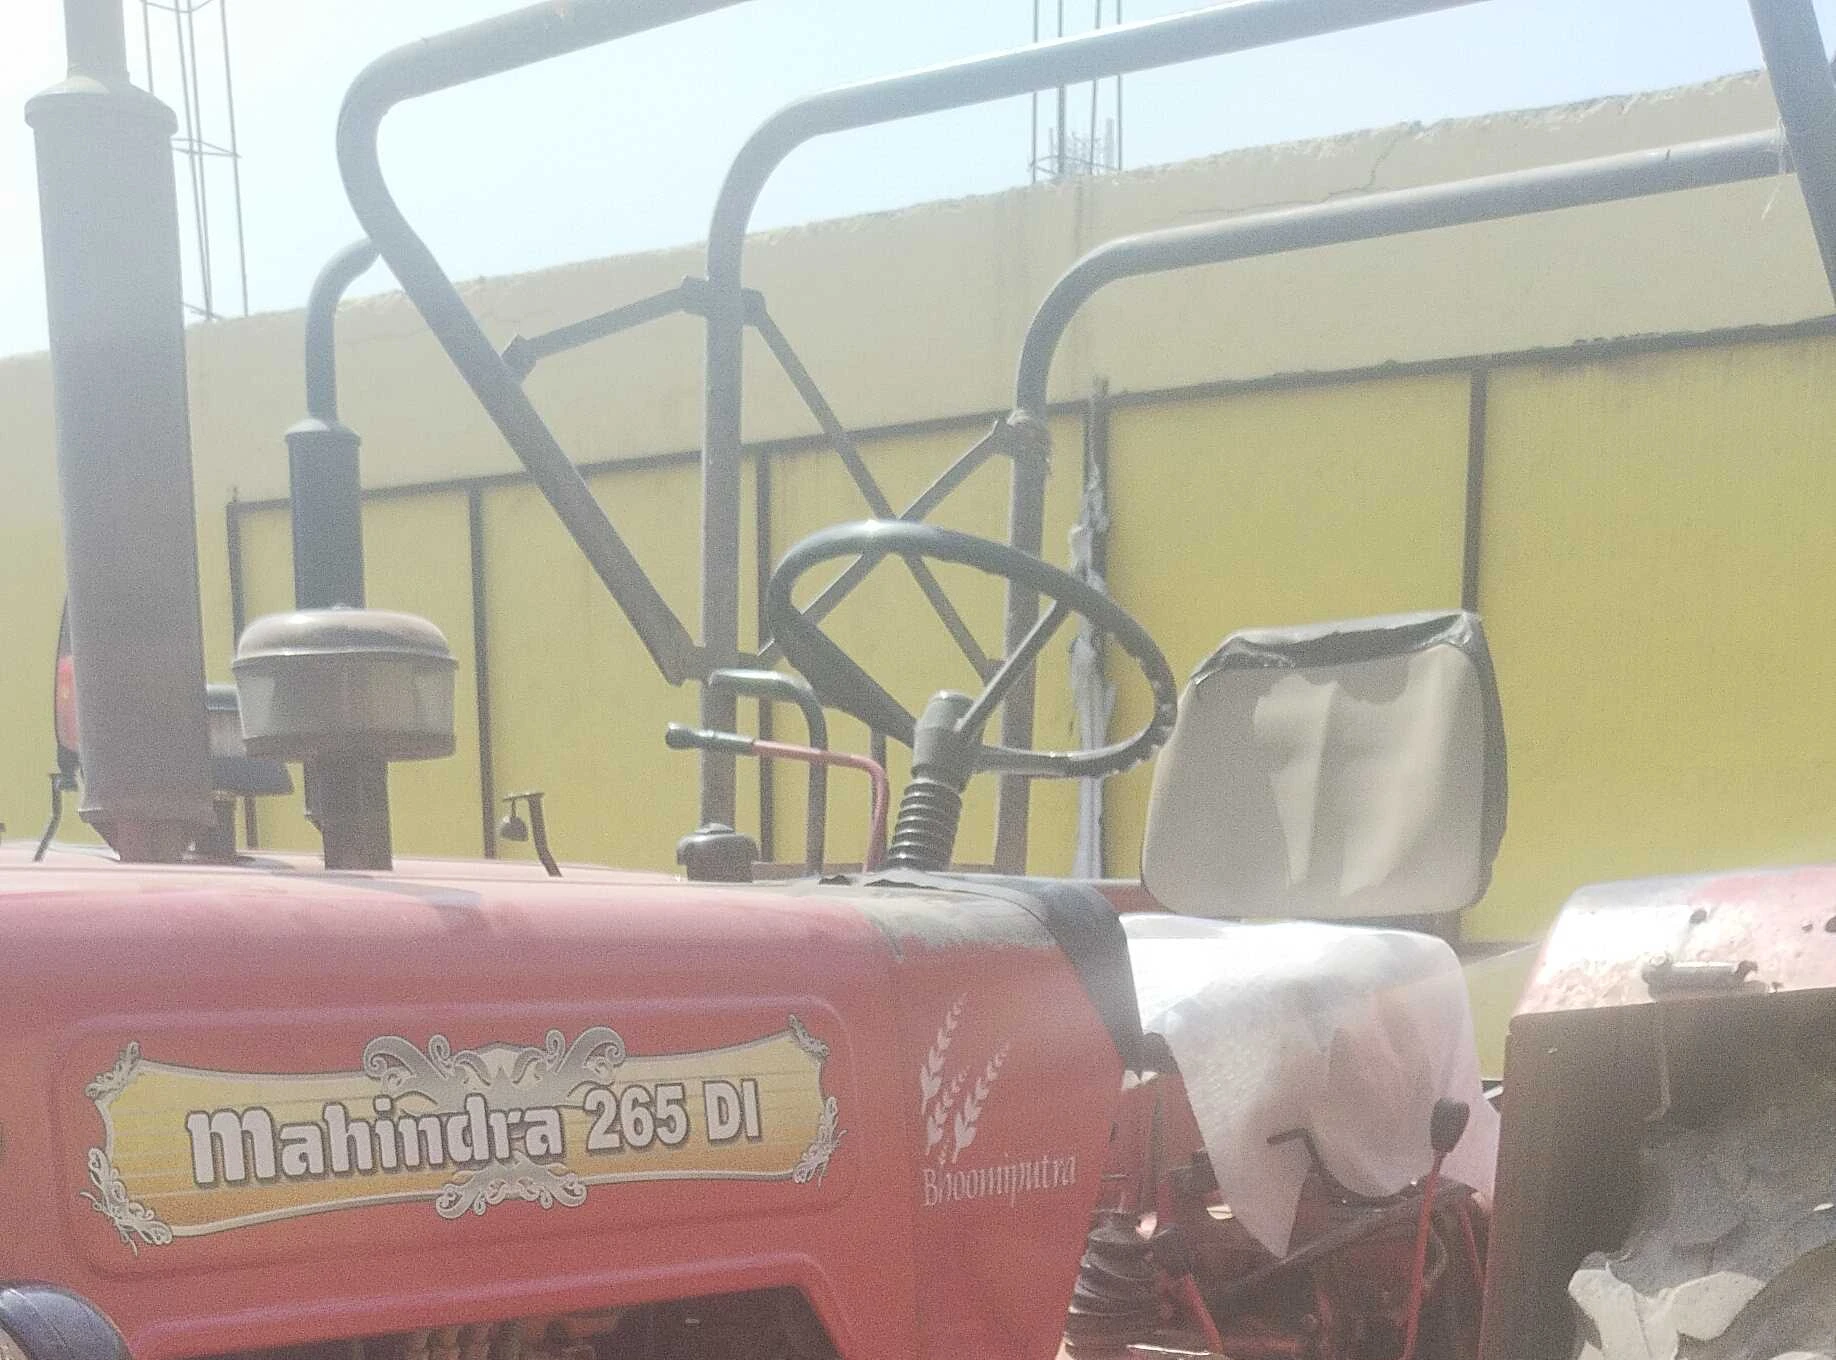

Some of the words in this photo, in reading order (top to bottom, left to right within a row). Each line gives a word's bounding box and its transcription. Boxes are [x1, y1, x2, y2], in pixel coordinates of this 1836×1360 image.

[188, 1094, 564, 1188] Mahindra
[585, 1081, 688, 1154] 265
[706, 1078, 764, 1144] DI
